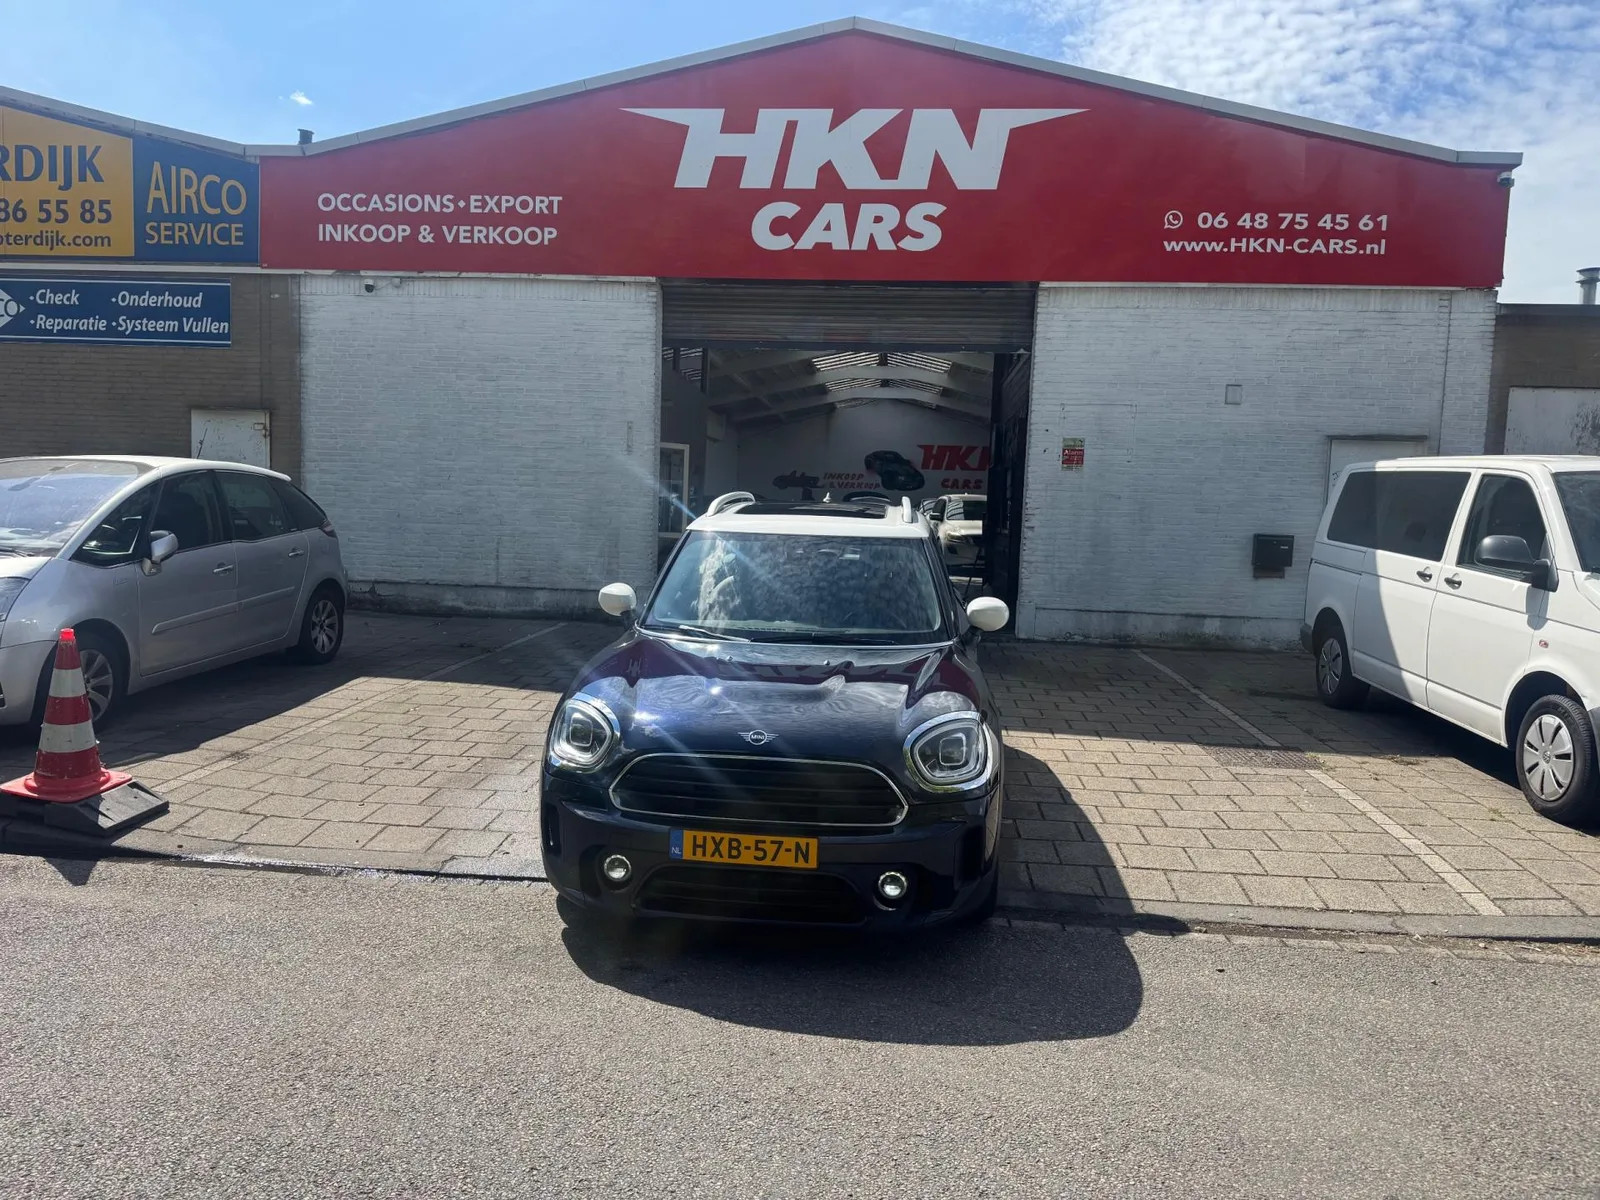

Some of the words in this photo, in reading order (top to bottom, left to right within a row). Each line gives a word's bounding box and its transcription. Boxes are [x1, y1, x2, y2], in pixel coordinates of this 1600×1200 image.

[619, 107, 1093, 190] HKN
[146, 160, 248, 216] AIRCO
[0, 197, 28, 223] 86
[37, 198, 70, 224] 55
[79, 199, 112, 224] 85
[317, 193, 455, 213] OCCASIONS
[469, 195, 563, 214] EXPORT
[751, 201, 948, 252] CARS
[1197, 212, 1229, 230] 06
[1237, 212, 1269, 230] 48
[1278, 213, 1309, 230] 75
[1317, 213, 1350, 231] 45
[1358, 214, 1389, 232] 61
[145, 222, 244, 246] SERVICE
[318, 223, 412, 243] INKOOP
[417, 225, 435, 244] &
[441, 225, 558, 246] VERKOOP
[1163, 237, 1386, 256] www.HKN-CARS.nl
[35, 288, 80, 306] Check
[117, 290, 203, 309] Onderhoud
[36, 314, 107, 333] Reparatie
[117, 315, 179, 335] Systeem
[182, 316, 229, 334] Vullen
[823, 471, 865, 481] INKOOP
[940, 478, 984, 490] CARS
[671, 846, 682, 855] NL
[691, 834, 811, 864] HXB-57-N
